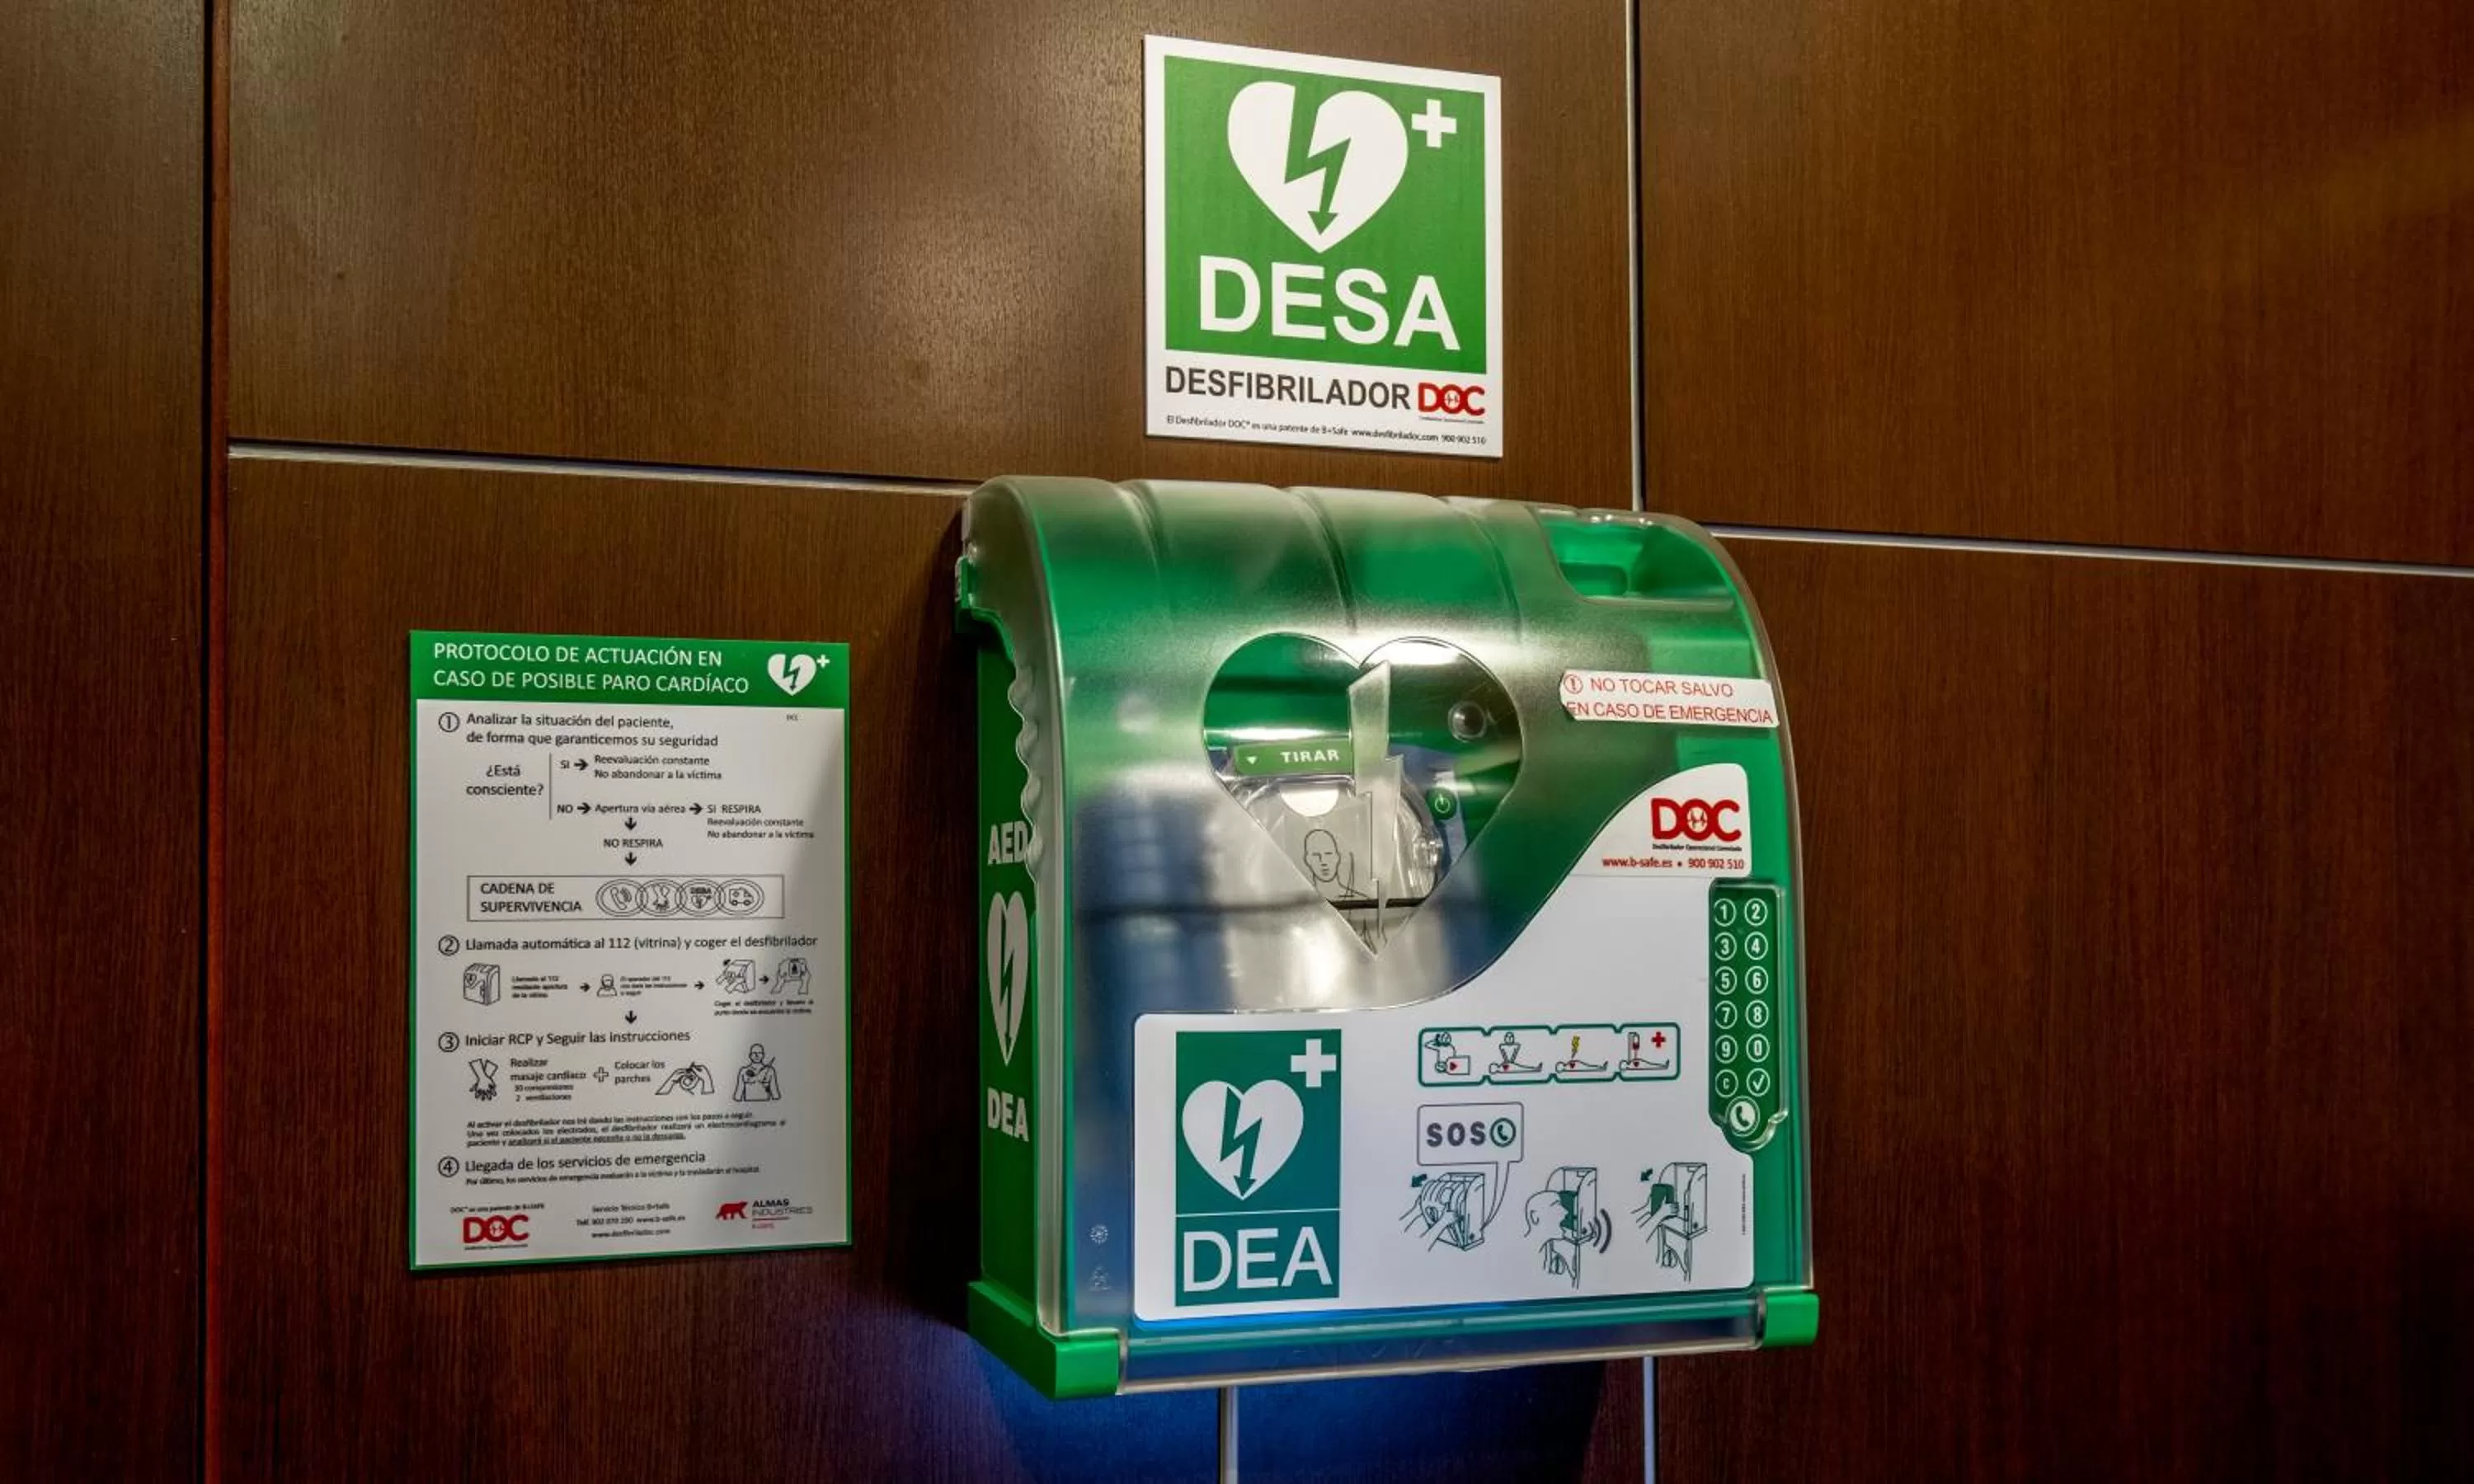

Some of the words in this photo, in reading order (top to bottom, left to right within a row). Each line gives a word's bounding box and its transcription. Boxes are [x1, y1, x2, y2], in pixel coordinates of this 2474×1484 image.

[1200, 255, 1460, 350] DESA
[1165, 366, 1410, 410] DESFIBRILADOR
[1418, 382, 1485, 416] DOC
[435, 643, 549, 661] PROTOCOLO
[556, 646, 579, 662] DE
[585, 646, 692, 666] ACTUACIÓN
[698, 650, 722, 667] EN
[434, 669, 485, 687] CASO
[492, 672, 515, 688] DE
[522, 672, 595, 690] POSIBLE
[603, 674, 650, 691] PARO
[656, 673, 749, 693] CARDÍACO
[1591, 678, 1615, 693] NO
[1620, 679, 1677, 695] TOCAR
[1681, 682, 1733, 697] SALVO
[1593, 702, 1639, 718] CASO
[1644, 704, 1666, 719] DE
[1669, 705, 1772, 723] EMERGENCIA
[467, 713, 517, 726] Analizar
[521, 714, 531, 726] la
[536, 714, 591, 726] situación
[595, 716, 614, 726] del
[618, 716, 674, 729] paciente,
[467, 731, 482, 743] de
[487, 731, 524, 743] forma
[528, 734, 550, 745] que
[555, 733, 637, 746] garanticemos
[642, 736, 656, 746] su
[659, 735, 717, 749] seguridad
[595, 754, 658, 765] Reevaluación
[662, 757, 709, 766] constante
[1280, 749, 1339, 763] TIRAR
[486, 765, 520, 777] ¿Está
[595, 769, 608, 778] No
[611, 769, 664, 779] abandonar
[676, 770, 684, 779] la
[466, 784, 544, 796] consciente?
[557, 804, 573, 814] NO
[595, 805, 639, 815] Apertura
[658, 804, 686, 814] aérea
[722, 805, 761, 814] RESPIRA
[1651, 798, 1742, 842] DOC
[603, 838, 619, 848] NO
[623, 838, 663, 848] RESPIRA
[988, 820, 1028, 866] AED
[1602, 857, 1672, 868] www.b-safe.es
[1688, 858, 1705, 868] 900
[1708, 858, 1724, 869] 902
[1728, 859, 1744, 870] 510
[481, 883, 534, 894] CADENA
[539, 883, 554, 894] DE
[481, 901, 582, 913] SUPERVIVENCIA
[466, 938, 518, 950] Llamada
[522, 937, 590, 950] automática
[595, 937, 604, 948] al
[609, 937, 630, 948] 112
[634, 937, 681, 950] (vitrina)
[684, 940, 691, 949] y
[694, 940, 727, 949] coger
[731, 936, 741, 946] el
[745, 936, 818, 947] desfibrilador
[466, 1034, 506, 1045] Iniciar
[508, 1034, 533, 1045] RCP
[536, 1036, 543, 1046] y
[547, 1033, 586, 1047] Seguir
[590, 1032, 606, 1043] las
[610, 1031, 690, 1043] instrucciones
[510, 1059, 548, 1068] Realizar
[614, 1060, 648, 1069] Colocar
[651, 1059, 665, 1069] los
[510, 1073, 544, 1082] masaje
[614, 1074, 651, 1083] parches
[988, 1087, 1029, 1142] DEA
[1427, 1121, 1485, 1147] SOS
[465, 1158, 513, 1173] Llegada
[517, 1158, 533, 1169] de
[537, 1157, 554, 1168] los
[558, 1156, 612, 1168] servicios
[615, 1154, 631, 1165] de
[634, 1152, 705, 1166] emergencia
[753, 1198, 789, 1207] ALMAS
[463, 1214, 529, 1243] DOC
[1183, 1226, 1333, 1293] DEA
